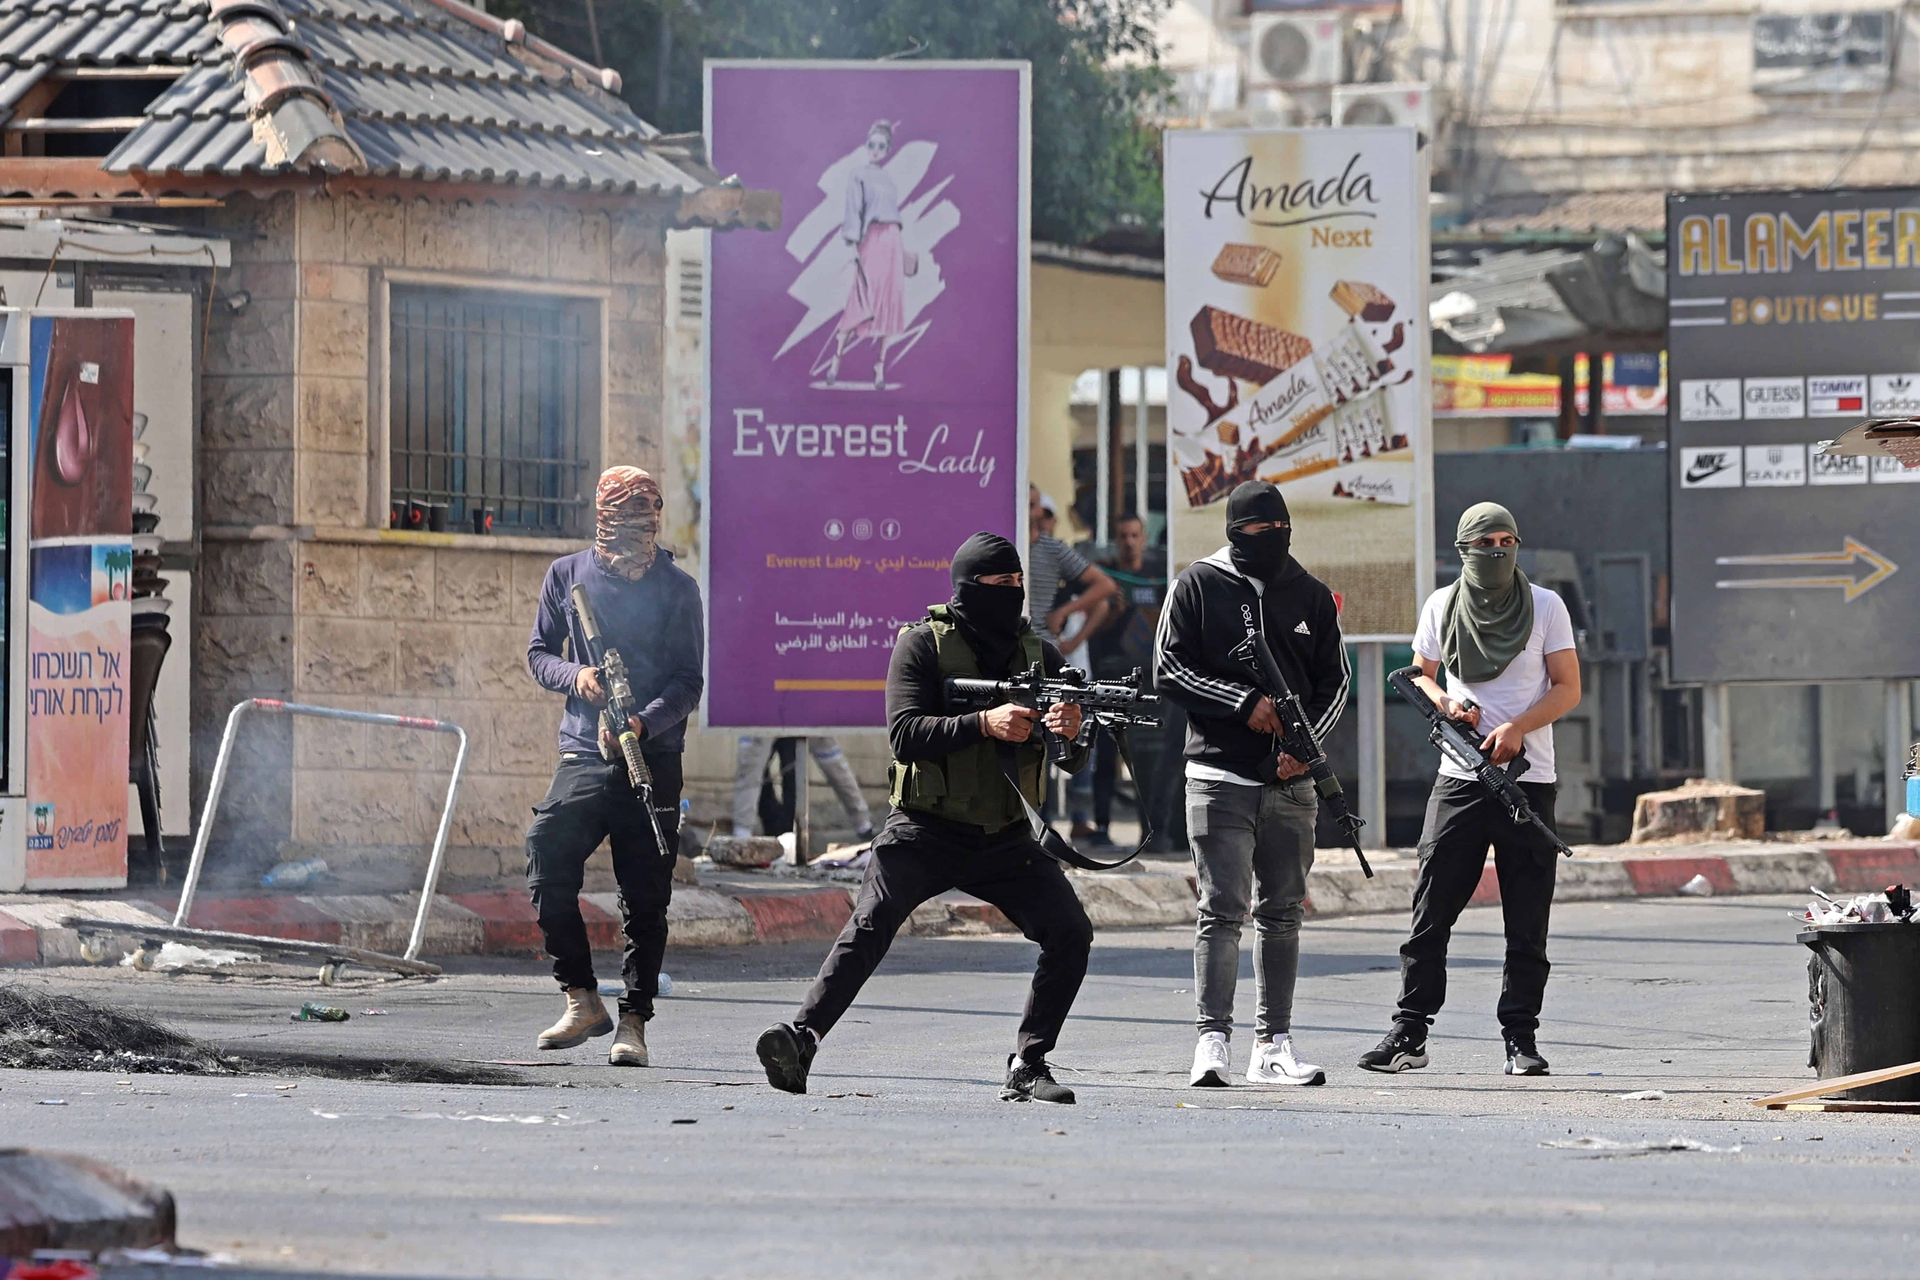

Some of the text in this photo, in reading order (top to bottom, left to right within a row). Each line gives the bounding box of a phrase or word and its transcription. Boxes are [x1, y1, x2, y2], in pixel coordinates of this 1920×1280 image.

[1199, 152, 1381, 220] Amada
[1311, 226, 1373, 249] Next
[1730, 293, 1878, 325] BOUTIQUE
[1745, 386, 1802, 404] GUESS
[1811, 381, 1862, 393] TOMMY
[1246, 372, 1312, 432] Amada
[1872, 398, 1920, 413] adida
[732, 408, 996, 488] Everest Lady
[1694, 453, 1727, 469] NIKE
[1745, 470, 1802, 481] GANT
[766, 554, 822, 569] Everest
[826, 554, 861, 571] Lady
[874, 555, 905, 573] ليدي
[849, 611, 873, 630] دوار
[825, 634, 868, 653] الطابق
[32, 646, 121, 679] אל תשכחו
[30, 681, 123, 725] לקחת אותי
